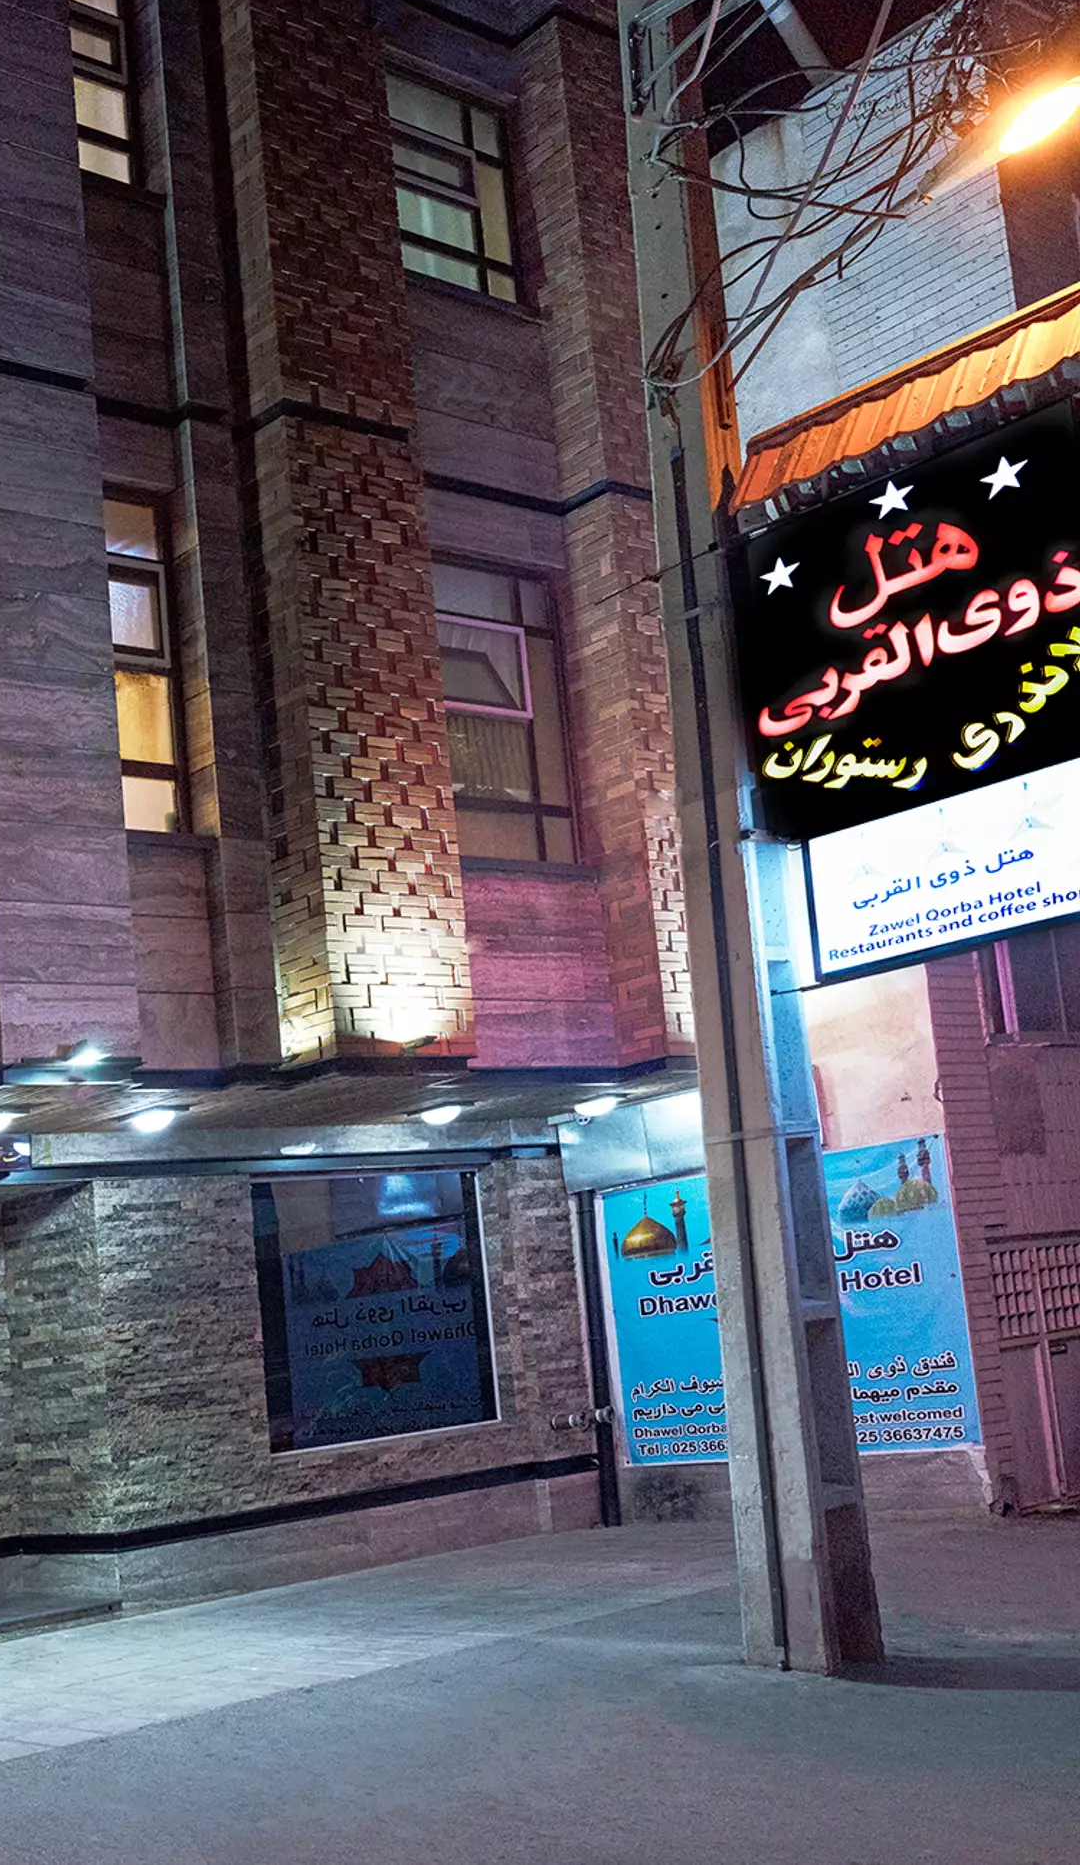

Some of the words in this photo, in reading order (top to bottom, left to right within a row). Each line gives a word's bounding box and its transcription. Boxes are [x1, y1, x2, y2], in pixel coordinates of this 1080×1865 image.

[829, 522, 979, 629] هتل
[762, 734, 927, 790] رستوران
[985, 848, 1034, 874] هتل
[869, 913, 920, 937] Zawel
[925, 898, 983, 922] Qorba
[989, 882, 1041, 906] Hotel
[829, 926, 933, 961] Restaurants
[938, 915, 973, 934] and
[978, 899, 1037, 923] coffee
[1042, 889, 1080, 908] sho
[840, 1262, 921, 1291] Hotel
[912, 1351, 956, 1376] فندق
[632, 1379, 675, 1400] الکرام
[852, 1387, 900, 1403] میهما
[906, 1381, 958, 1400] مقدم
[633, 1403, 677, 1421] داریم
[634, 1425, 683, 1439] Dhawel
[686, 1422, 728, 1438] Qorba
[879, 1406, 963, 1423] welcomed
[639, 1444, 659, 1456] Tel
[672, 1441, 697, 1454] 025
[858, 1431, 880, 1444] 25
[883, 1426, 963, 1442] 36637475
